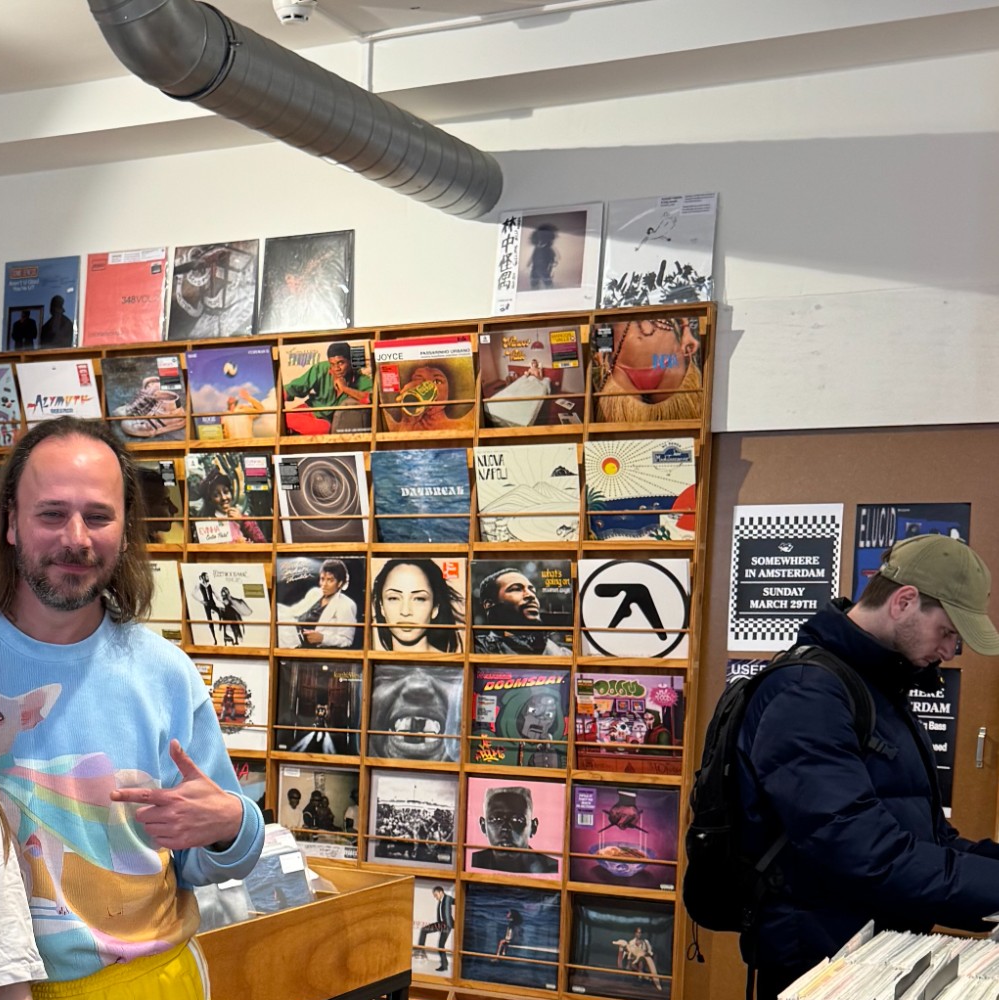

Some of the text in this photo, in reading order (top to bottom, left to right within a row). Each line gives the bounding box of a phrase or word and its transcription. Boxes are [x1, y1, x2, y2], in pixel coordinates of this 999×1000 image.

[377, 353, 404, 361] JOYCE
[477, 454, 505, 467] NUOVA
[478, 467, 509, 480] NAPOLI
[859, 507, 897, 548] ELUCID
[751, 556, 820, 566] SOMEWHERE
[744, 568, 825, 578] IN AMSTERDAM
[762, 587, 805, 597] SUNDAY
[749, 600, 818, 609] MARCH 29TH
[911, 701, 951, 713] RDAM
[928, 721, 947, 731] Bass
